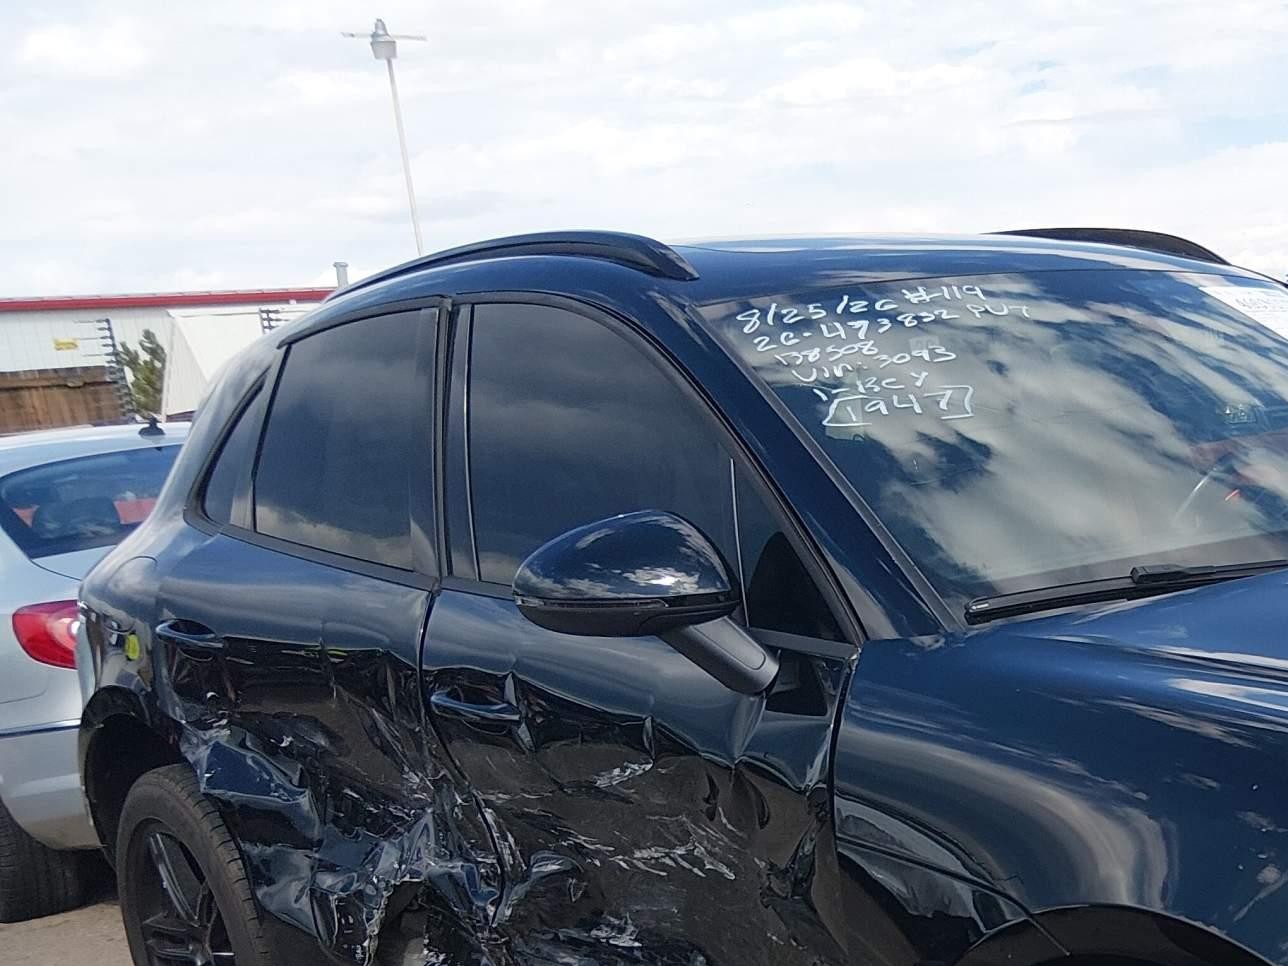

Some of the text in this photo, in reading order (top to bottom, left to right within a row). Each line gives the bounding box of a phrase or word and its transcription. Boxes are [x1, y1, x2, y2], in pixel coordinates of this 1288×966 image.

[736, 285, 986, 334] 8/25/26 #119
[774, 339, 879, 366] 138508
